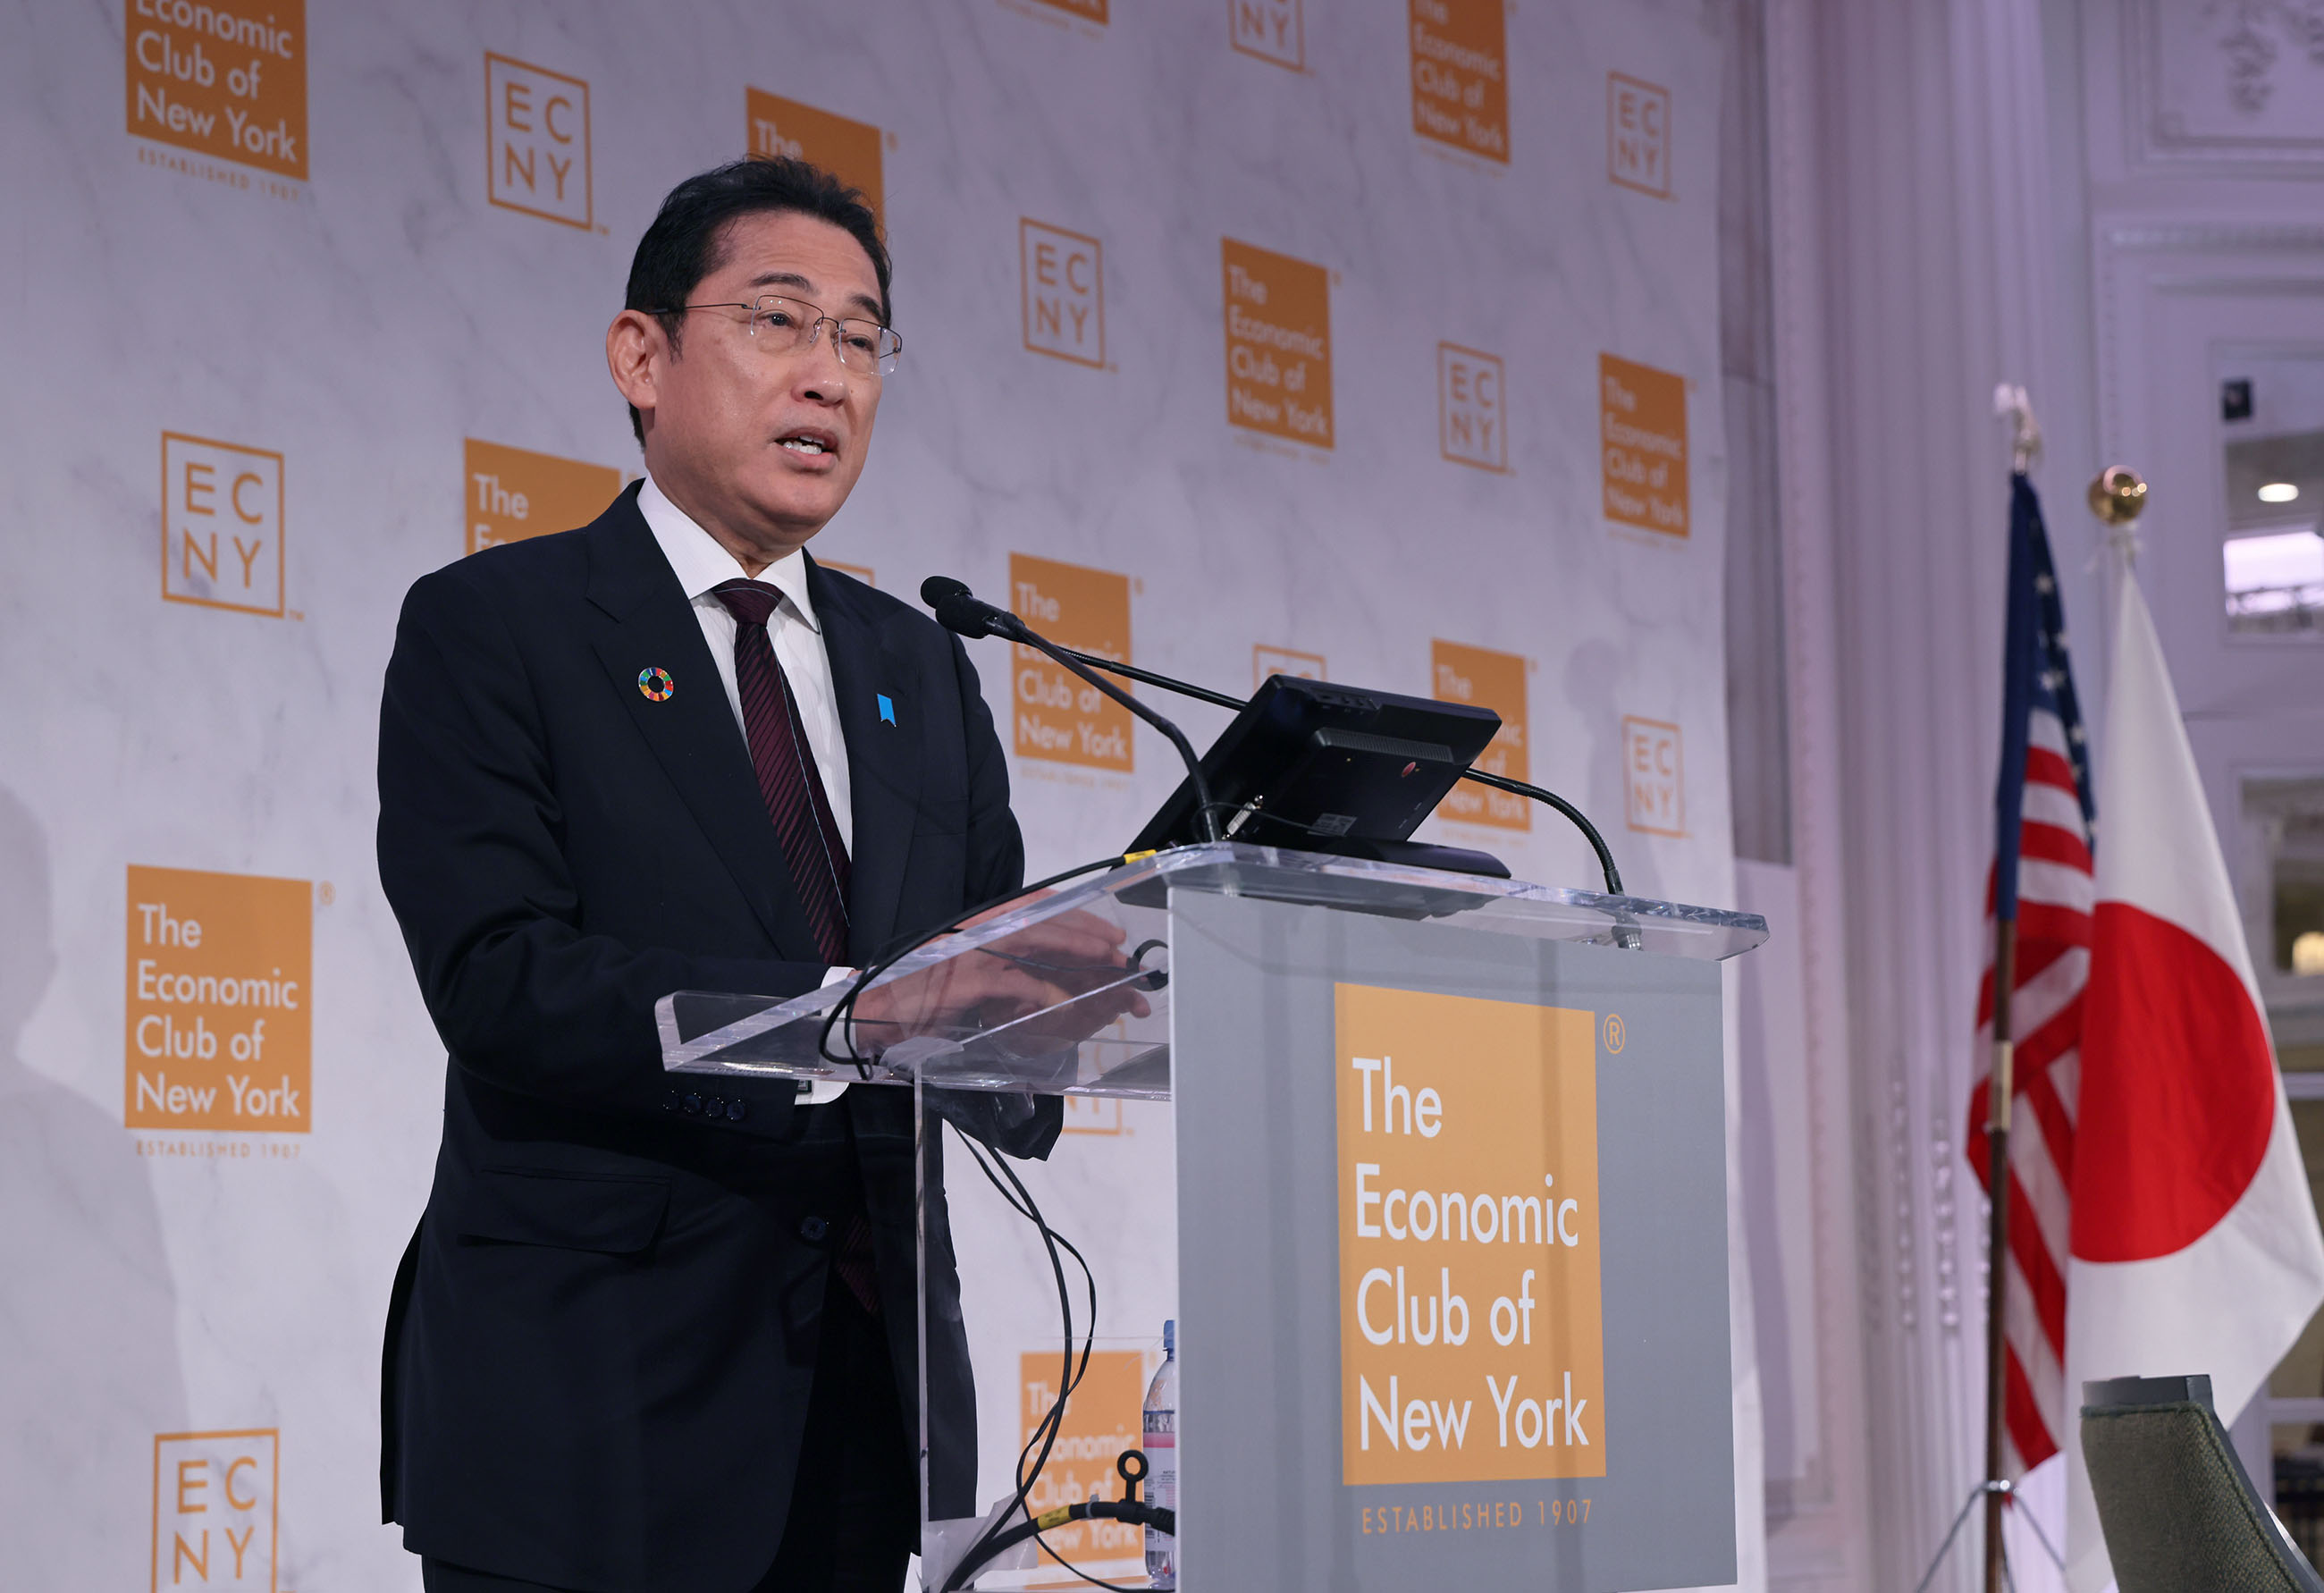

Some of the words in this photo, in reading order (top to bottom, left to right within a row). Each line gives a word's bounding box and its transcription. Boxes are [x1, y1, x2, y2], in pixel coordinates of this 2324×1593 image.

[136, 30, 215, 87] Club
[227, 59, 261, 100] of
[1415, 60, 1460, 101] Club
[138, 80, 215, 138] New
[225, 105, 299, 164] York
[1228, 265, 1268, 306] The
[1229, 304, 1325, 360] Economic
[1231, 345, 1280, 387] Club
[1284, 359, 1307, 392] of
[1232, 386, 1280, 423] New
[1283, 397, 1327, 435] York
[1607, 448, 1646, 485] Club
[473, 472, 529, 520] The
[1015, 582, 1059, 621] The
[1017, 669, 1072, 712] Club
[1078, 686, 1101, 714] of
[1437, 664, 1473, 701] The
[1019, 713, 1073, 751] New
[1077, 721, 1127, 760] York
[137, 903, 202, 948] The
[138, 959, 298, 1009] Economic
[137, 1014, 217, 1058] Club
[230, 1019, 265, 1061] of
[137, 1071, 216, 1115] New
[226, 1075, 299, 1117] York
[1352, 1056, 1443, 1138] The
[1356, 1163, 1579, 1247] Economic
[1357, 1266, 1470, 1346] Club
[1490, 1268, 1535, 1345] of
[1360, 1373, 1472, 1452] New
[1486, 1371, 1590, 1449] York
[1362, 1502, 1522, 1534] ESTABLISHED
[1538, 1499, 1592, 1526] 1907
